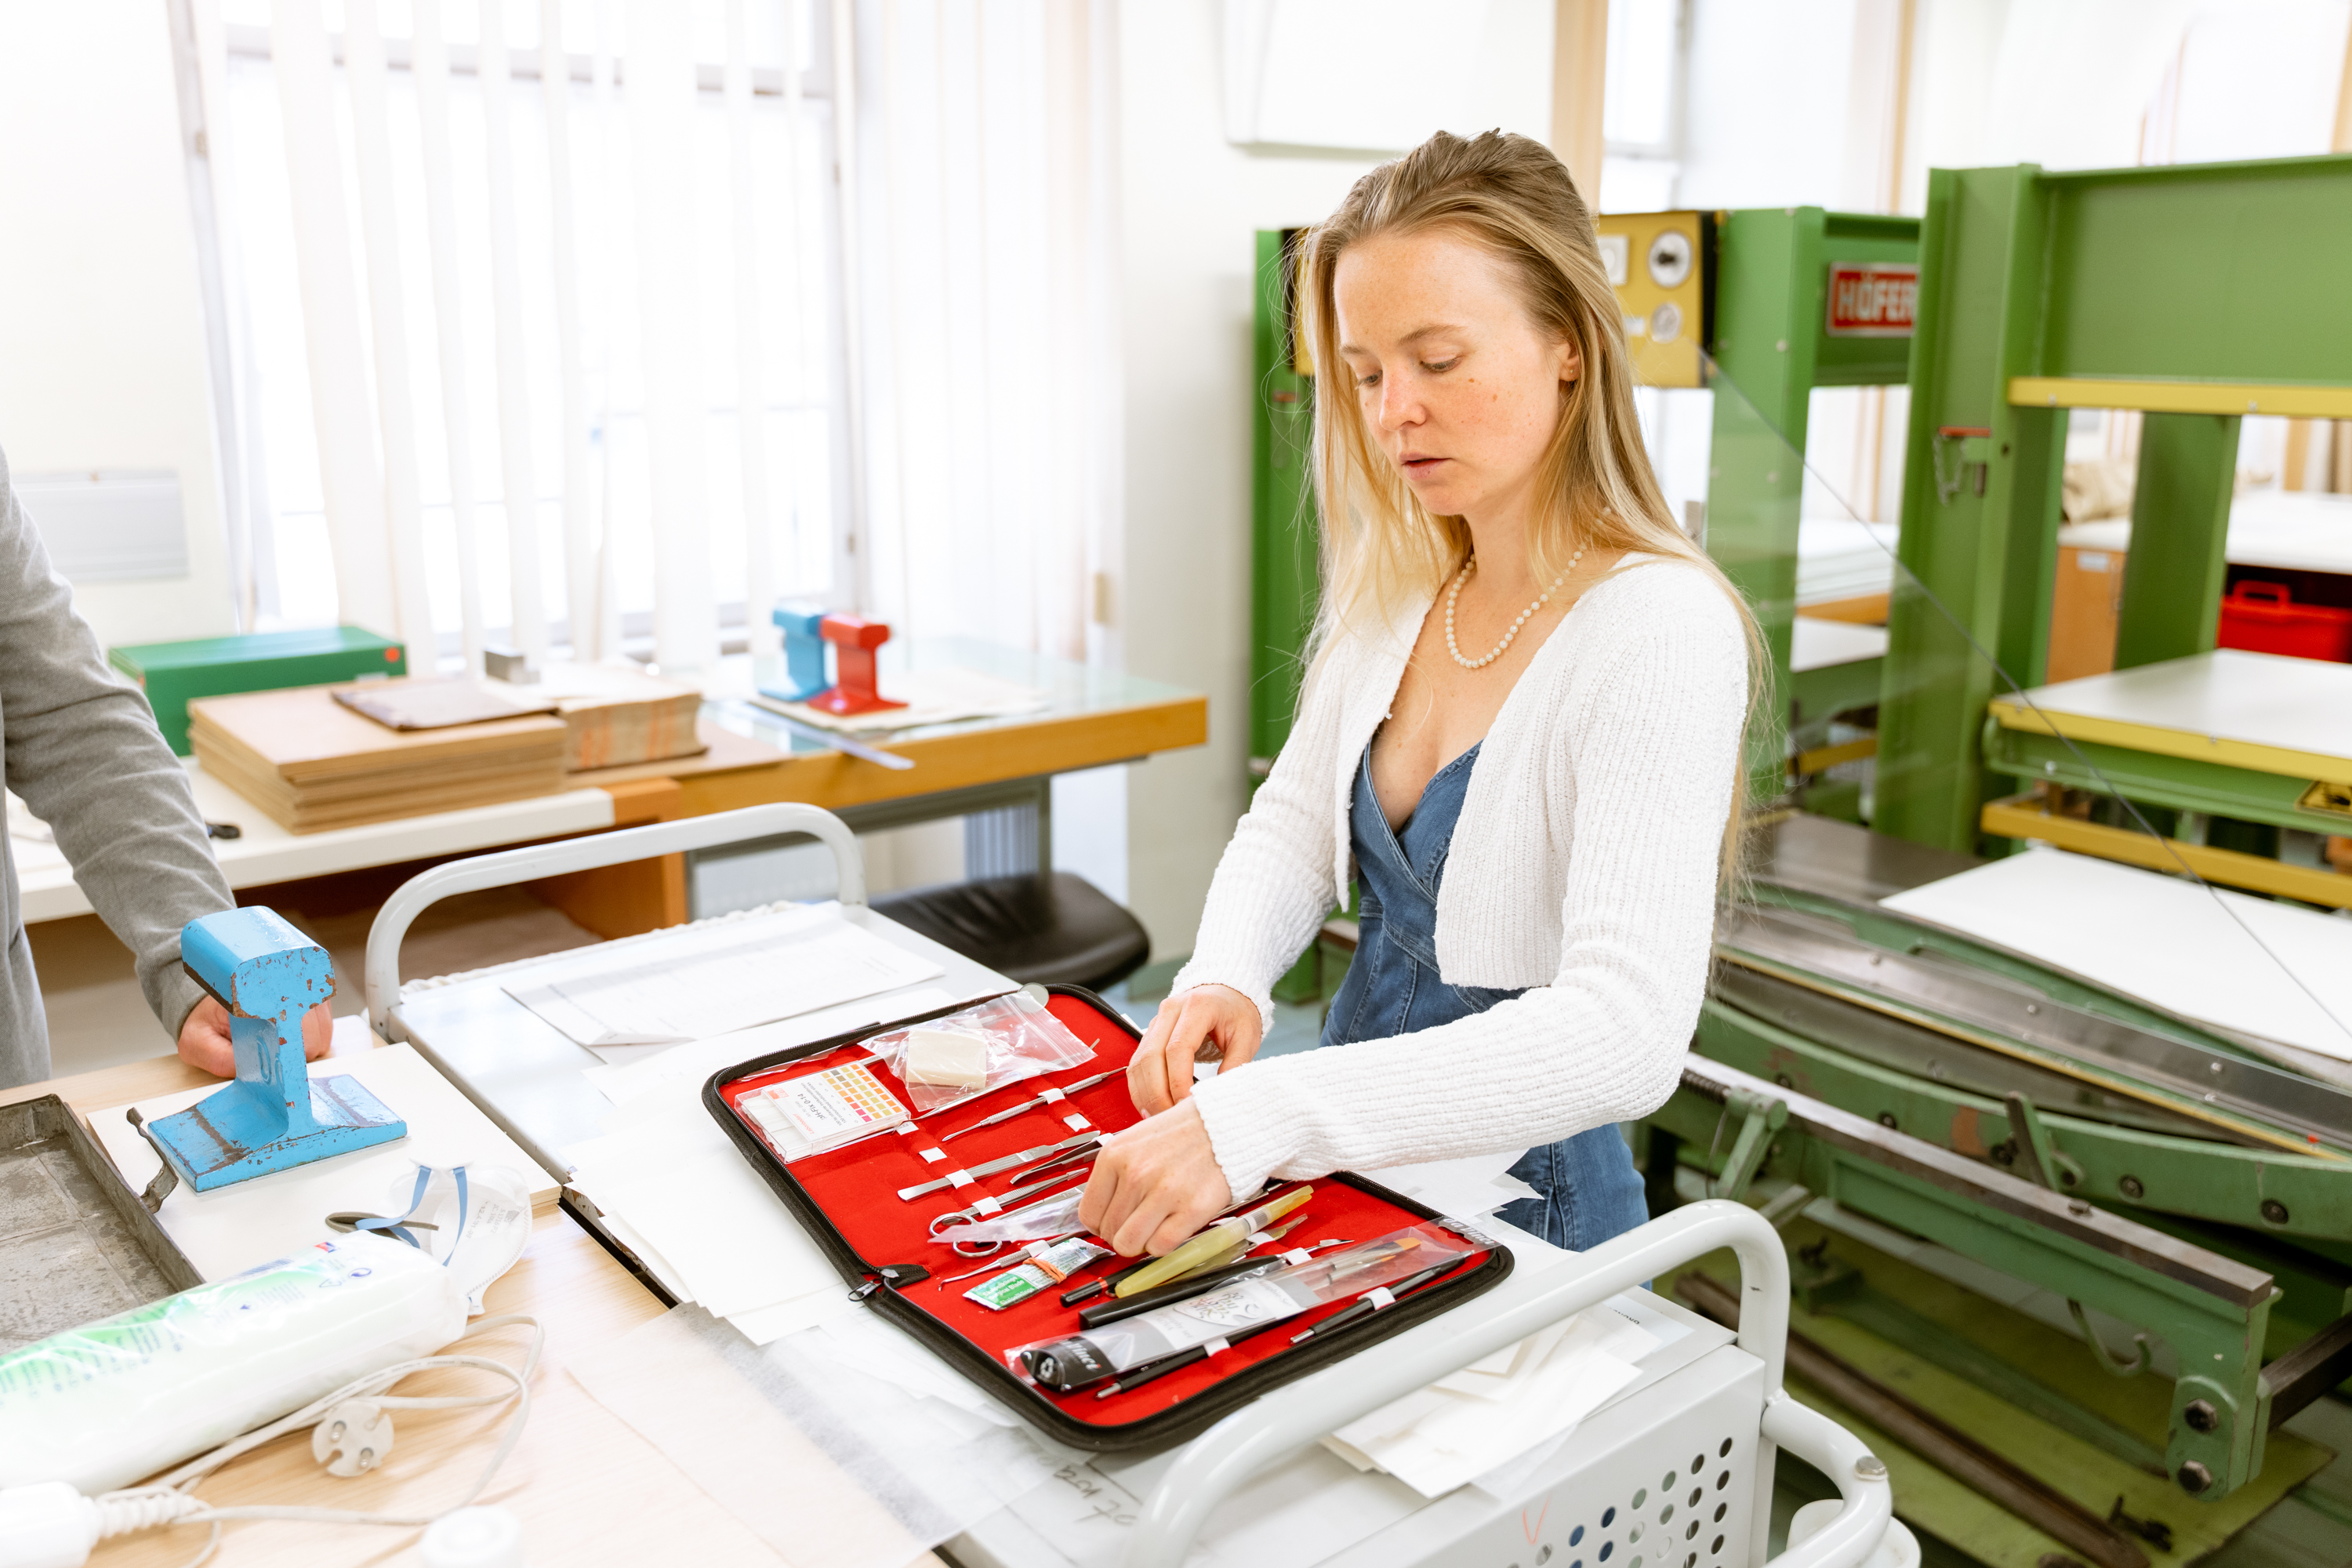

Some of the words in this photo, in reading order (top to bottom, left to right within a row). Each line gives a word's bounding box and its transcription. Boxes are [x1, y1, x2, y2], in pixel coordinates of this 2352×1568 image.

[797, 1093, 811, 1104] 0-14
[806, 1104, 827, 1120] pH-Fix
[1008, 1279, 1025, 1290] Blade
